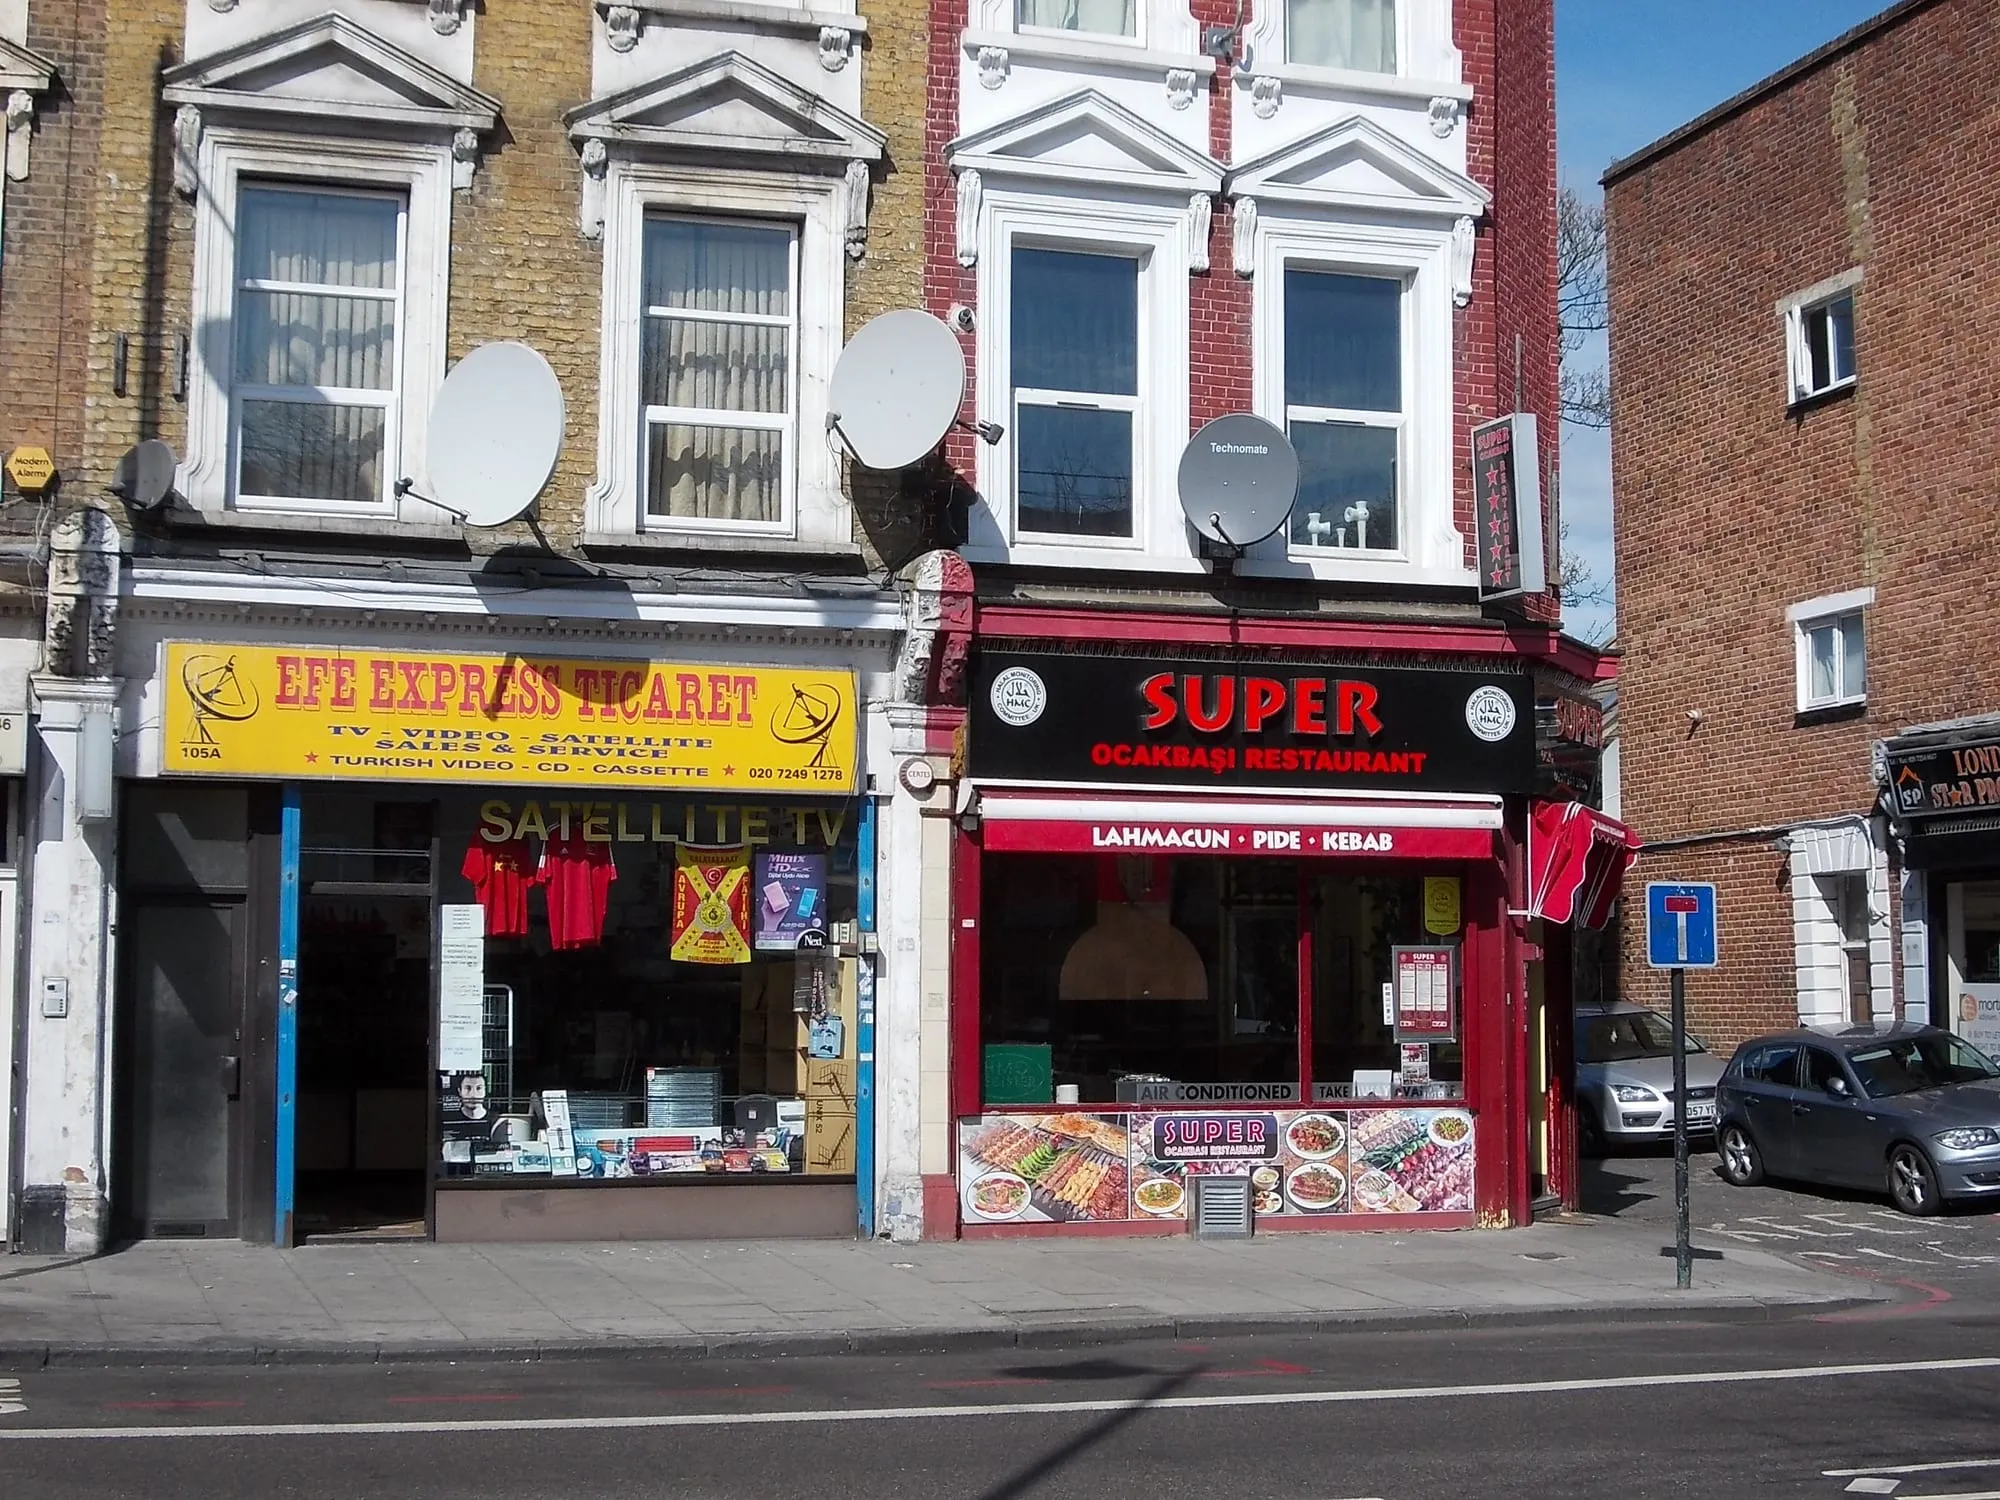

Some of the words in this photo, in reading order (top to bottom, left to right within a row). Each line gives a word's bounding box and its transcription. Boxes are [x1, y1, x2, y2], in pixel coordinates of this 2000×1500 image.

[1477, 427, 1509, 451] SUPER
[1209, 442, 1268, 455] Technomate
[15, 457, 49, 465] Modern
[17, 468, 46, 478] Alarms
[1500, 460, 1511, 582] RESTAURANT
[274, 655, 357, 713] EFE
[368, 659, 563, 721] EXPRESS
[573, 664, 758, 728] TICARET
[1006, 698, 1031, 708] HMC
[1140, 671, 1384, 737] SUPER
[1479, 715, 1502, 724] HMC
[328, 726, 370, 737] TV
[400, 728, 510, 741] VIDEO
[540, 733, 713, 749] SATELLITE
[181, 747, 221, 759] 105A
[375, 740, 481, 752] SALES
[527, 745, 668, 759] SERVICE
[330, 754, 433, 768] TURKISH
[441, 758, 515, 771] VIDEO
[537, 762, 570, 773] CD
[592, 764, 709, 777] CASSETTE
[1090, 743, 1235, 775] OCAKBAŞI
[1244, 748, 1428, 774] RESTAURANT
[749, 767, 773, 780] 020
[777, 768, 808, 780] 7249
[812, 769, 843, 781] 1278
[1903, 788, 1921, 805] SP
[480, 800, 770, 845] SATELLITE
[791, 806, 848, 847] TV
[1092, 827, 1230, 849] LAHMACUN
[1252, 831, 1300, 850] PIDE
[1322, 831, 1393, 851] KEBAB
[768, 863, 791, 872] HD
[676, 874, 687, 928] AVRUPA
[1141, 1086, 1168, 1100] AIR
[1176, 1085, 1291, 1100] CONDITIONED
[1319, 1086, 1348, 1098] TAKE
[1164, 1120, 1265, 1144] SUPER
[1210, 1145, 1266, 1155] RESTAURANT
